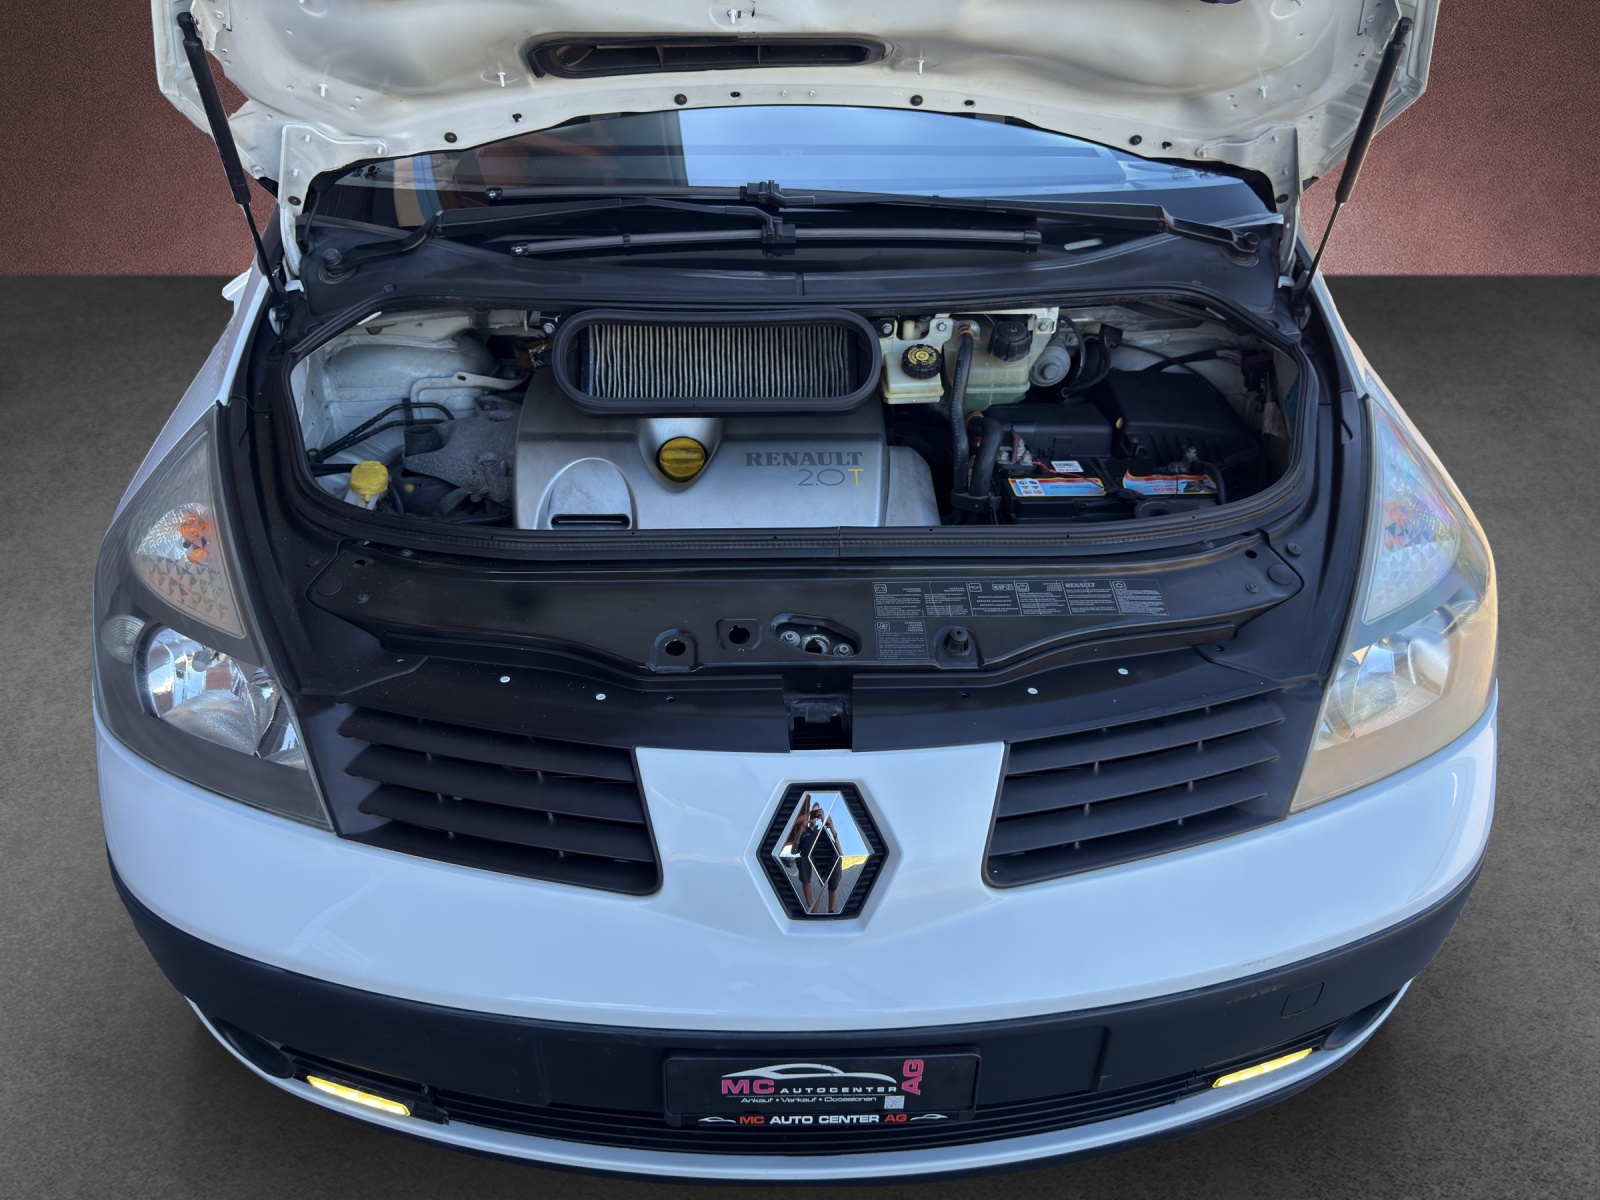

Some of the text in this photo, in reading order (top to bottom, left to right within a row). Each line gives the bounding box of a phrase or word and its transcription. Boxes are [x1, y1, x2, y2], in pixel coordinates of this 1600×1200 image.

[744, 452, 863, 466] RENAULT
[901, 1058, 924, 1095] AG
[721, 1079, 897, 1094] MC AUTOCENTER
[740, 1096, 774, 1104] Ankauf
[780, 1096, 817, 1104] Verkauf
[739, 1114, 908, 1125] MC AUTO CENTER AG
